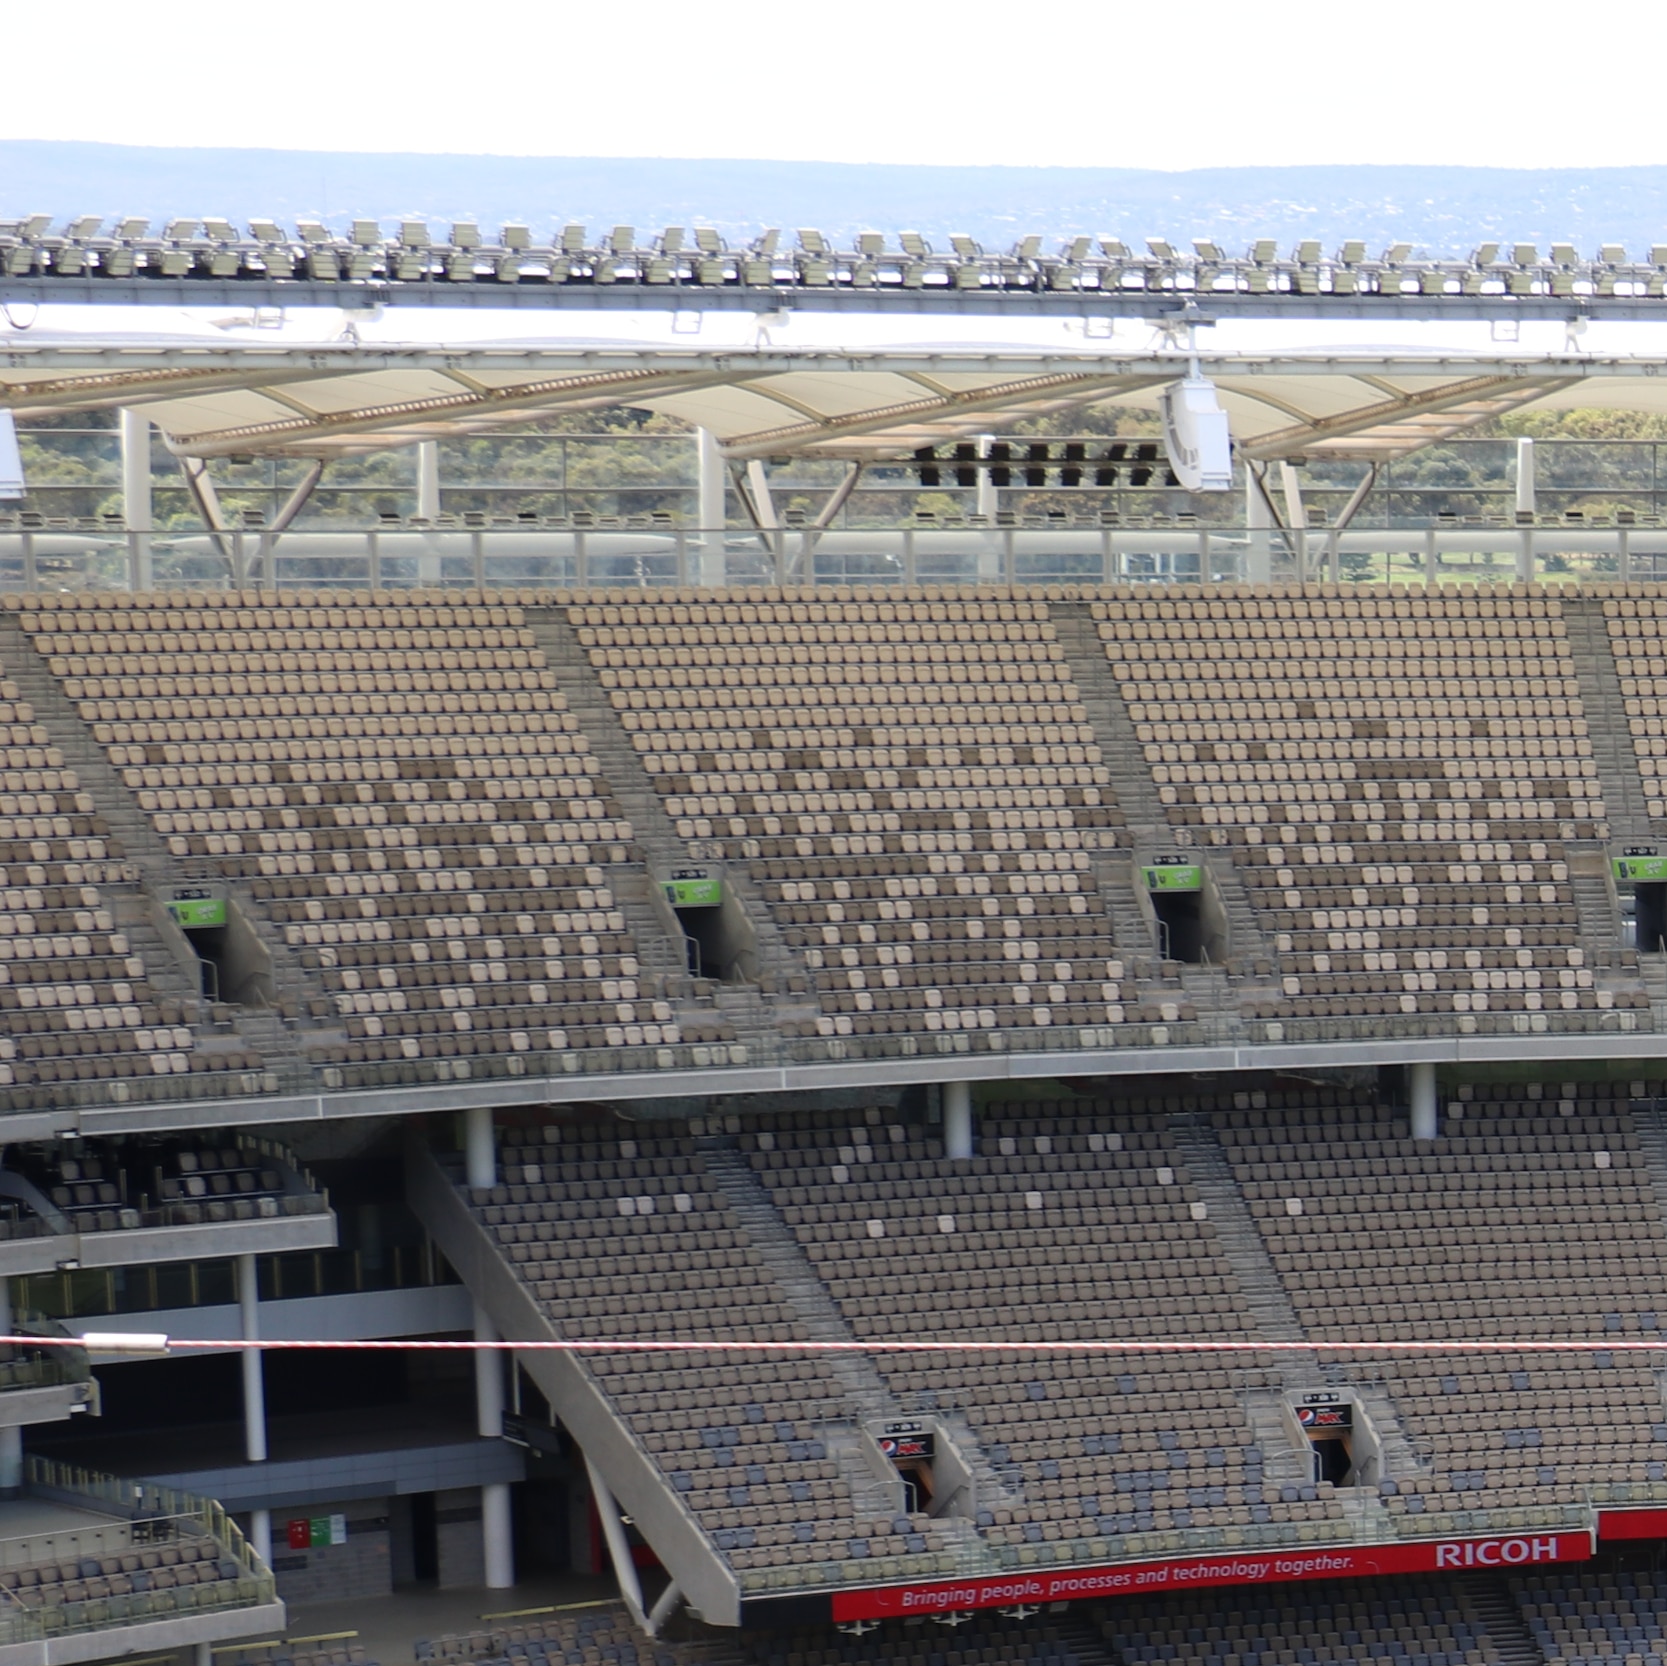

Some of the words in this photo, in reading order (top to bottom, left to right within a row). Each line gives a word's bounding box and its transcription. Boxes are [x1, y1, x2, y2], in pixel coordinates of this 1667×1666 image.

[1436, 1537, 1558, 1567] RICOH
[902, 1587, 976, 1609] Bringing
[981, 1581, 1044, 1602] people,
[1050, 1575, 1130, 1596] processes
[1136, 1568, 1169, 1584] and
[1174, 1561, 1268, 1583] technology
[1276, 1555, 1354, 1577] together.
